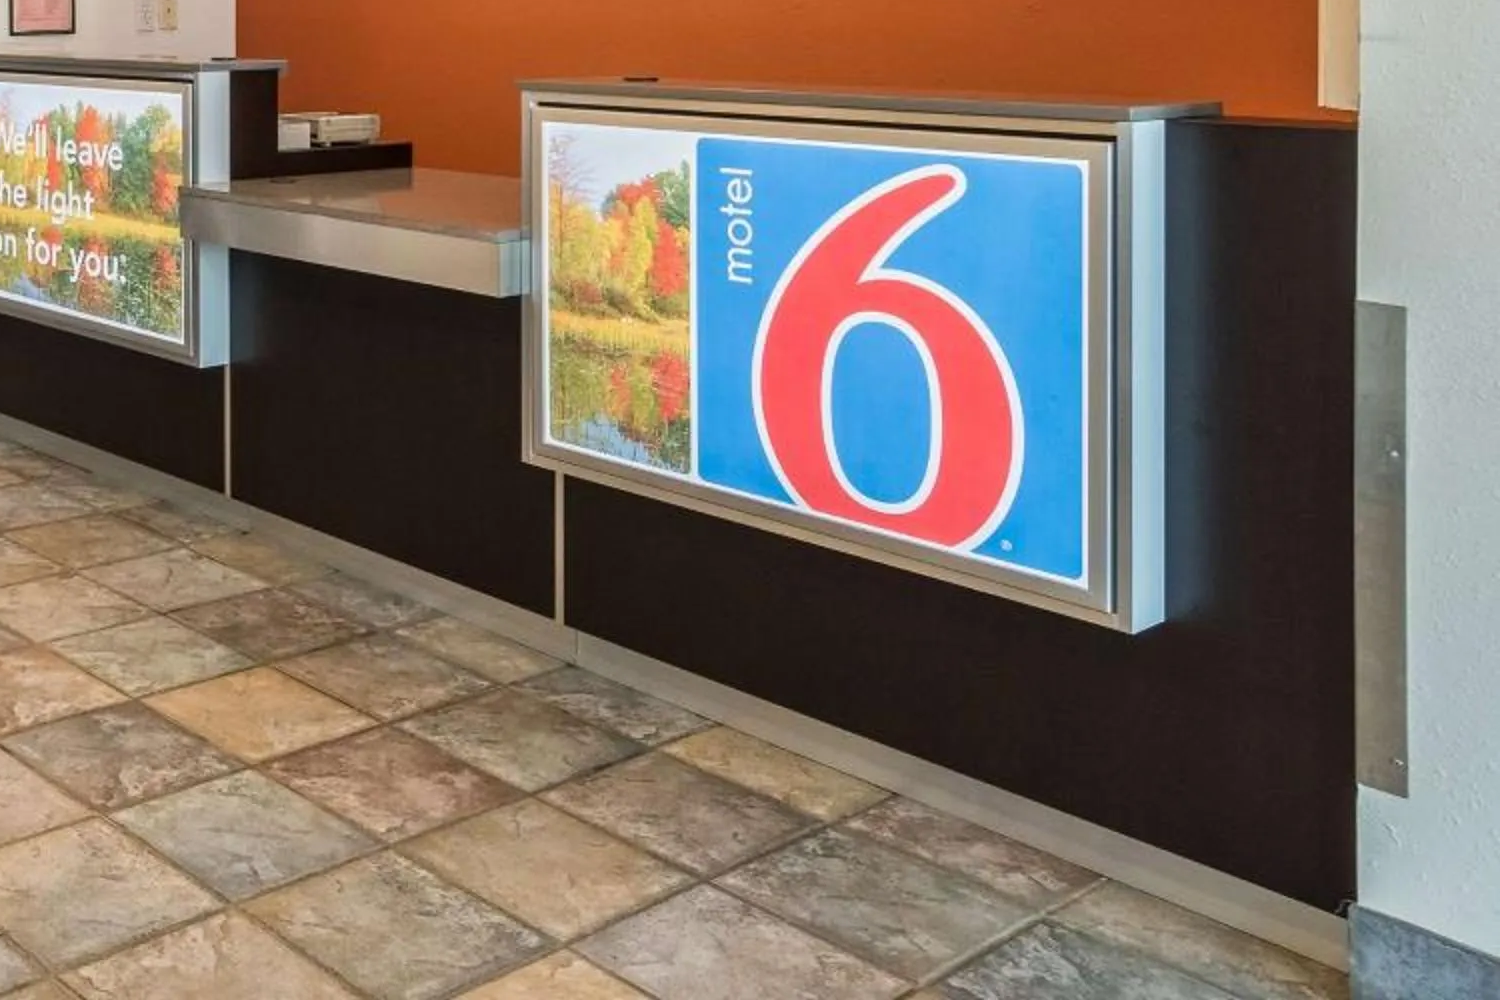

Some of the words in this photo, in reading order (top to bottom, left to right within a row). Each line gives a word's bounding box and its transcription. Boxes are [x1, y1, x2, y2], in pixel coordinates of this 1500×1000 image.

[56, 127, 124, 170] leave
[36, 176, 95, 225] light
[25, 227, 62, 267] for
[719, 166, 754, 285] motel
[751, 163, 1025, 553] 6
